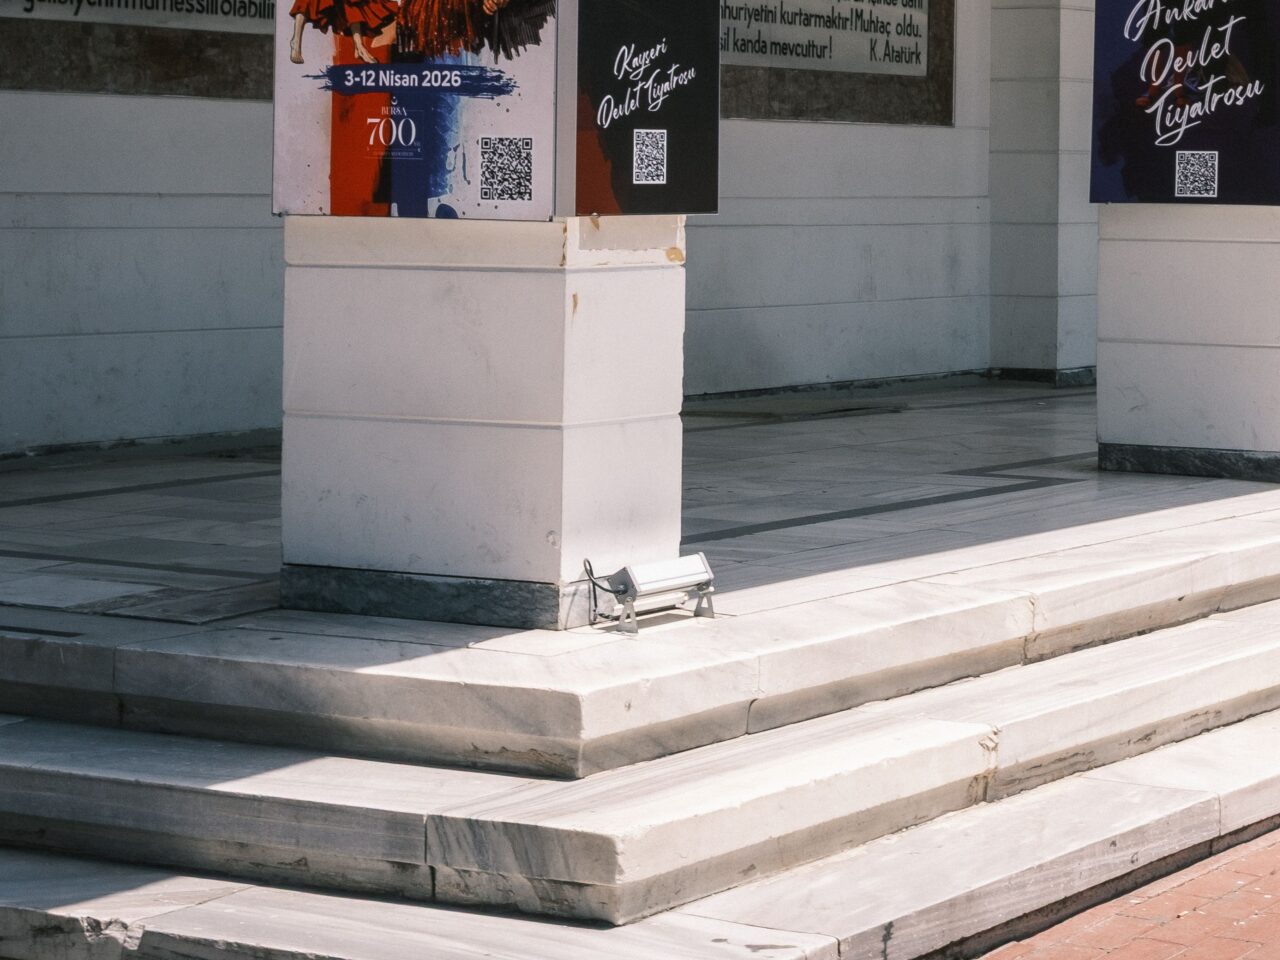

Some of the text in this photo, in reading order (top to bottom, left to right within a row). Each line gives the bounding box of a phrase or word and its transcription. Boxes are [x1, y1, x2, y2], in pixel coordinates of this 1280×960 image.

[855, 9, 891, 37] Muhtaç
[614, 38, 667, 80] Kayseri
[733, 30, 767, 55] kanda
[1140, 15, 1246, 86] Devlet
[344, 70, 461, 86] 3-12 Nisan 2026
[597, 64, 696, 128] Devlet Tiyatrosu
[1145, 74, 1264, 146] Tiyatrosu
[367, 118, 416, 147] 700
